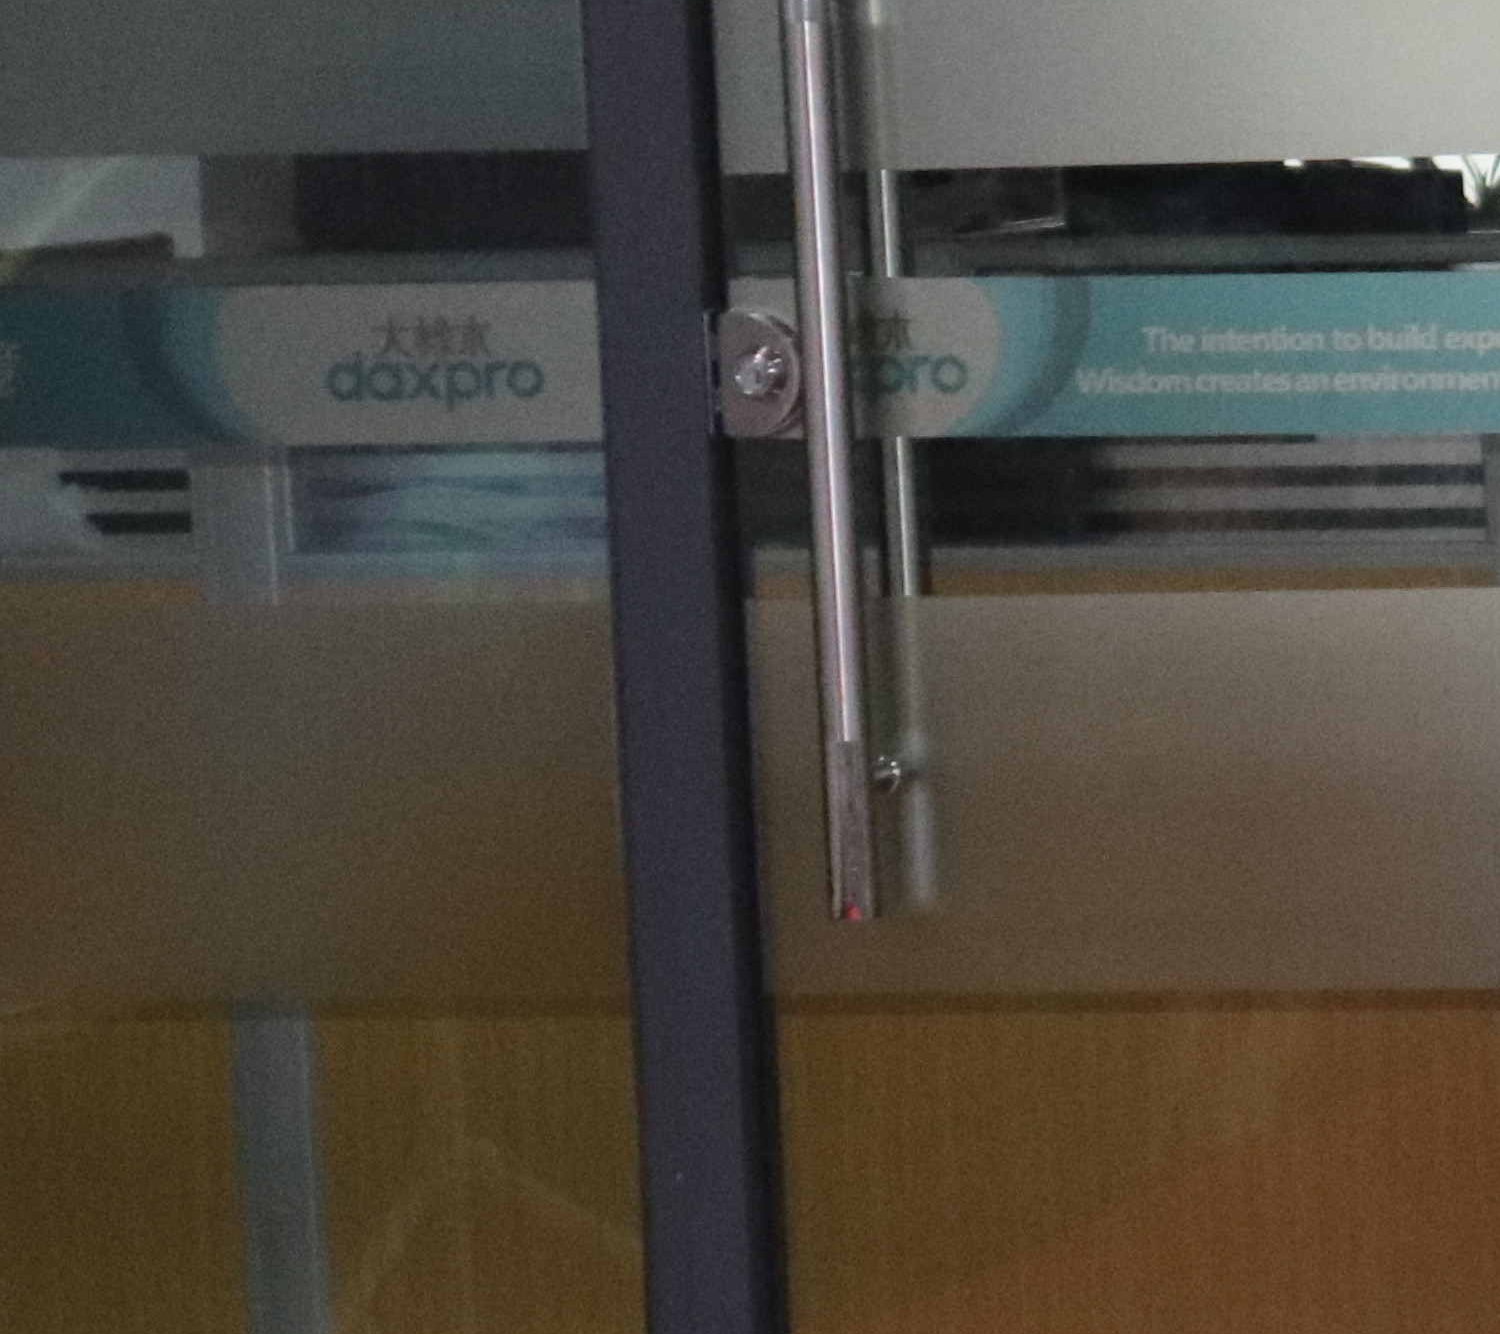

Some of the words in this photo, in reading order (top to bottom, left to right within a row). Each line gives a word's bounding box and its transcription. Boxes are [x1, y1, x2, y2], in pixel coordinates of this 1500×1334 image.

[1142, 326, 1195, 353] The
[1200, 324, 1325, 352] intention
[1332, 328, 1363, 352] to
[1367, 323, 1437, 351] build
[324, 351, 544, 411] daxpro
[1076, 366, 1195, 394] Wisdom
[1196, 369, 1291, 393] creates
[1295, 371, 1330, 393] an
